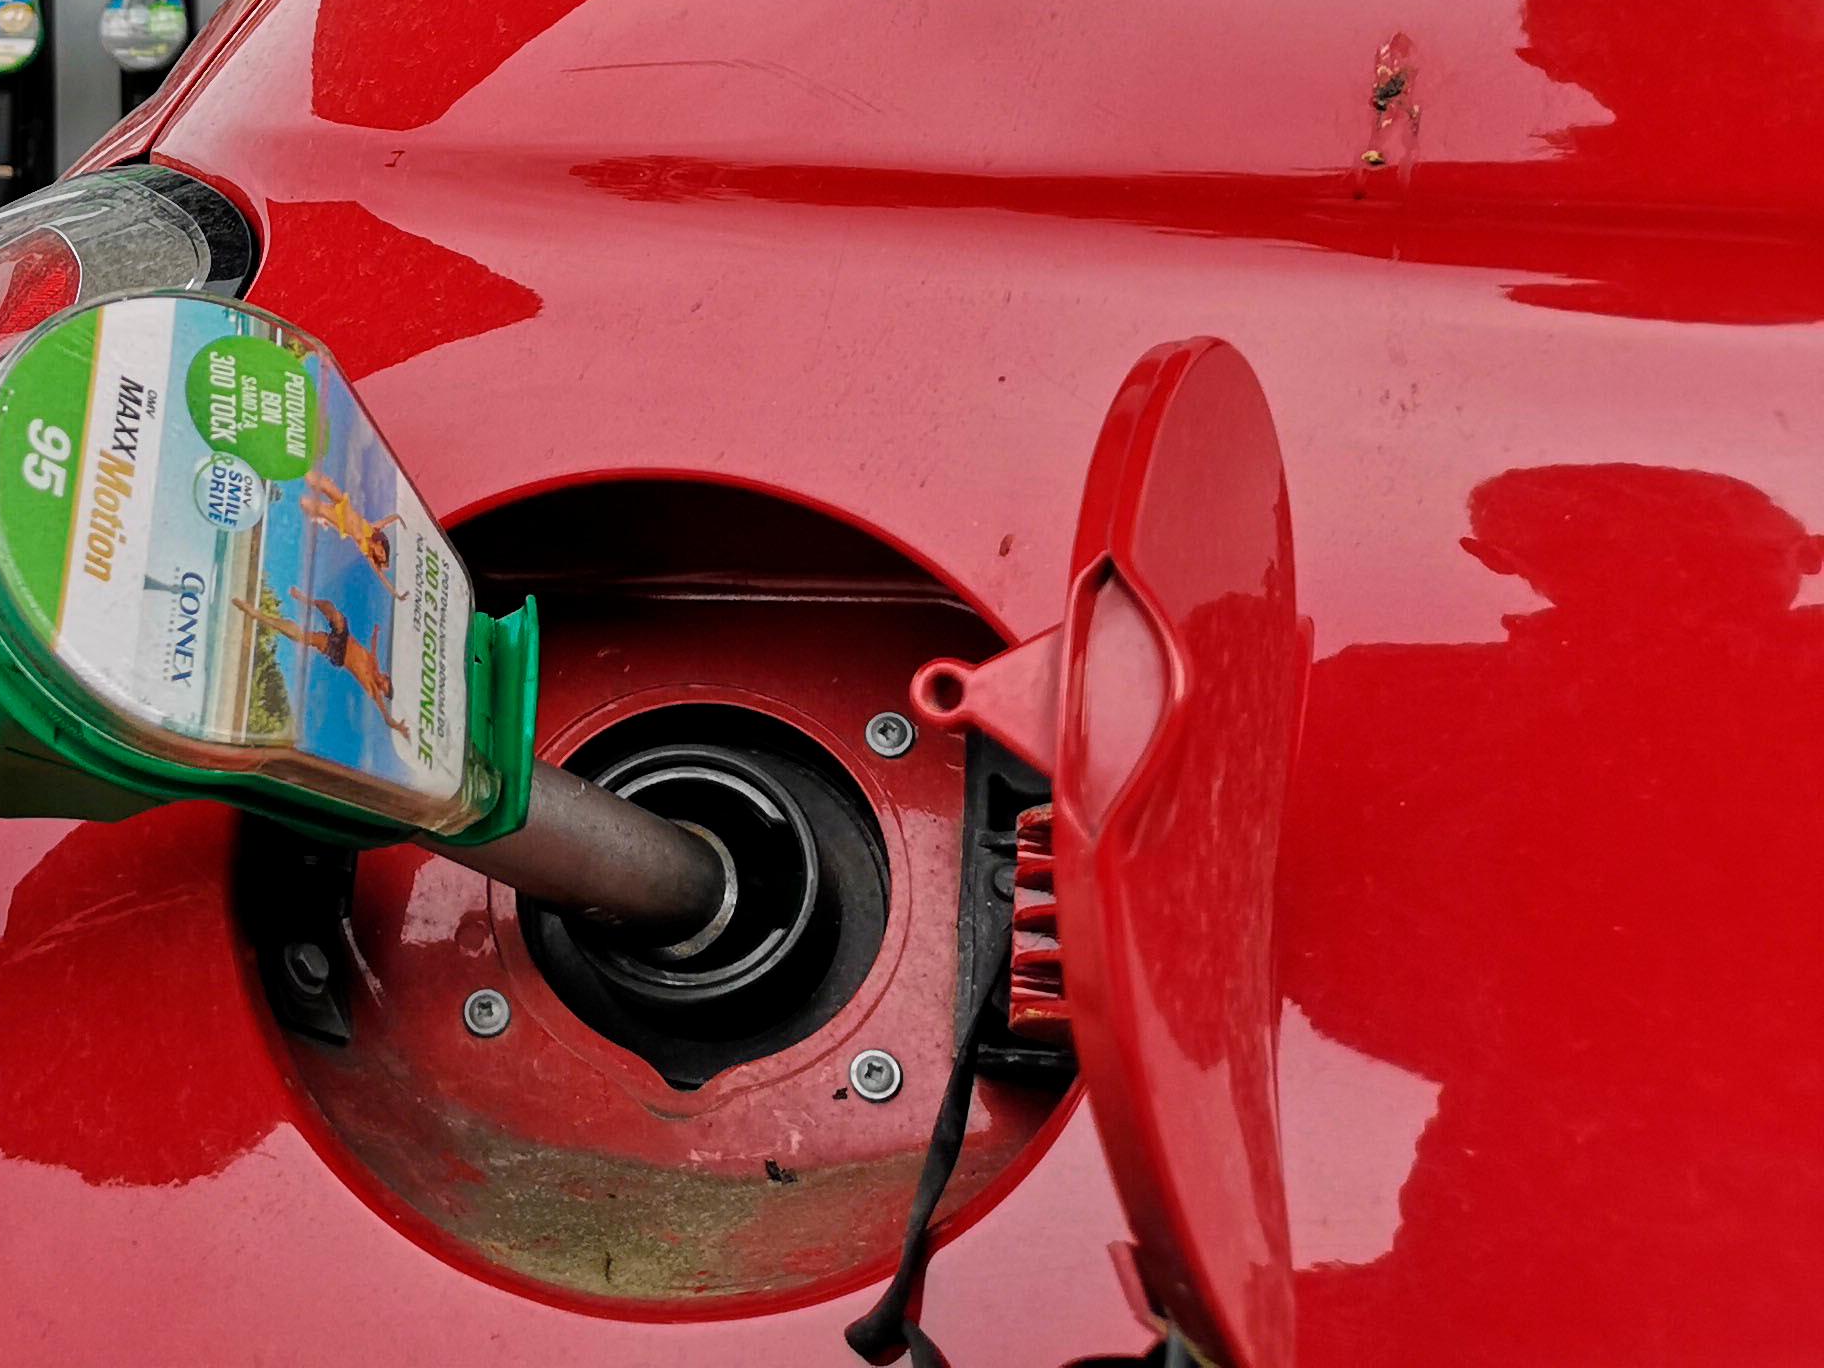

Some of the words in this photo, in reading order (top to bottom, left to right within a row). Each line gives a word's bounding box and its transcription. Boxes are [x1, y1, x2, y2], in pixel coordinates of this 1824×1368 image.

[209, 351, 236, 389] 300
[241, 375, 257, 412] SAMO
[111, 374, 145, 461] MAXX
[145, 389, 158, 420] OMV
[210, 393, 243, 444] TOČK
[242, 413, 258, 429] ZA
[260, 390, 282, 425] BON
[284, 371, 306, 458] POTOVALNI
[22, 418, 71, 498] 95
[84, 449, 135, 582] Motion
[208, 465, 226, 523] DRIVE
[224, 470, 243, 528] SMILE
[243, 475, 253, 509] OMV
[426, 545, 439, 590] 100
[171, 572, 205, 688] CONNEX
[418, 611, 437, 770] UGODNEJE
[437, 716, 445, 738] DO
